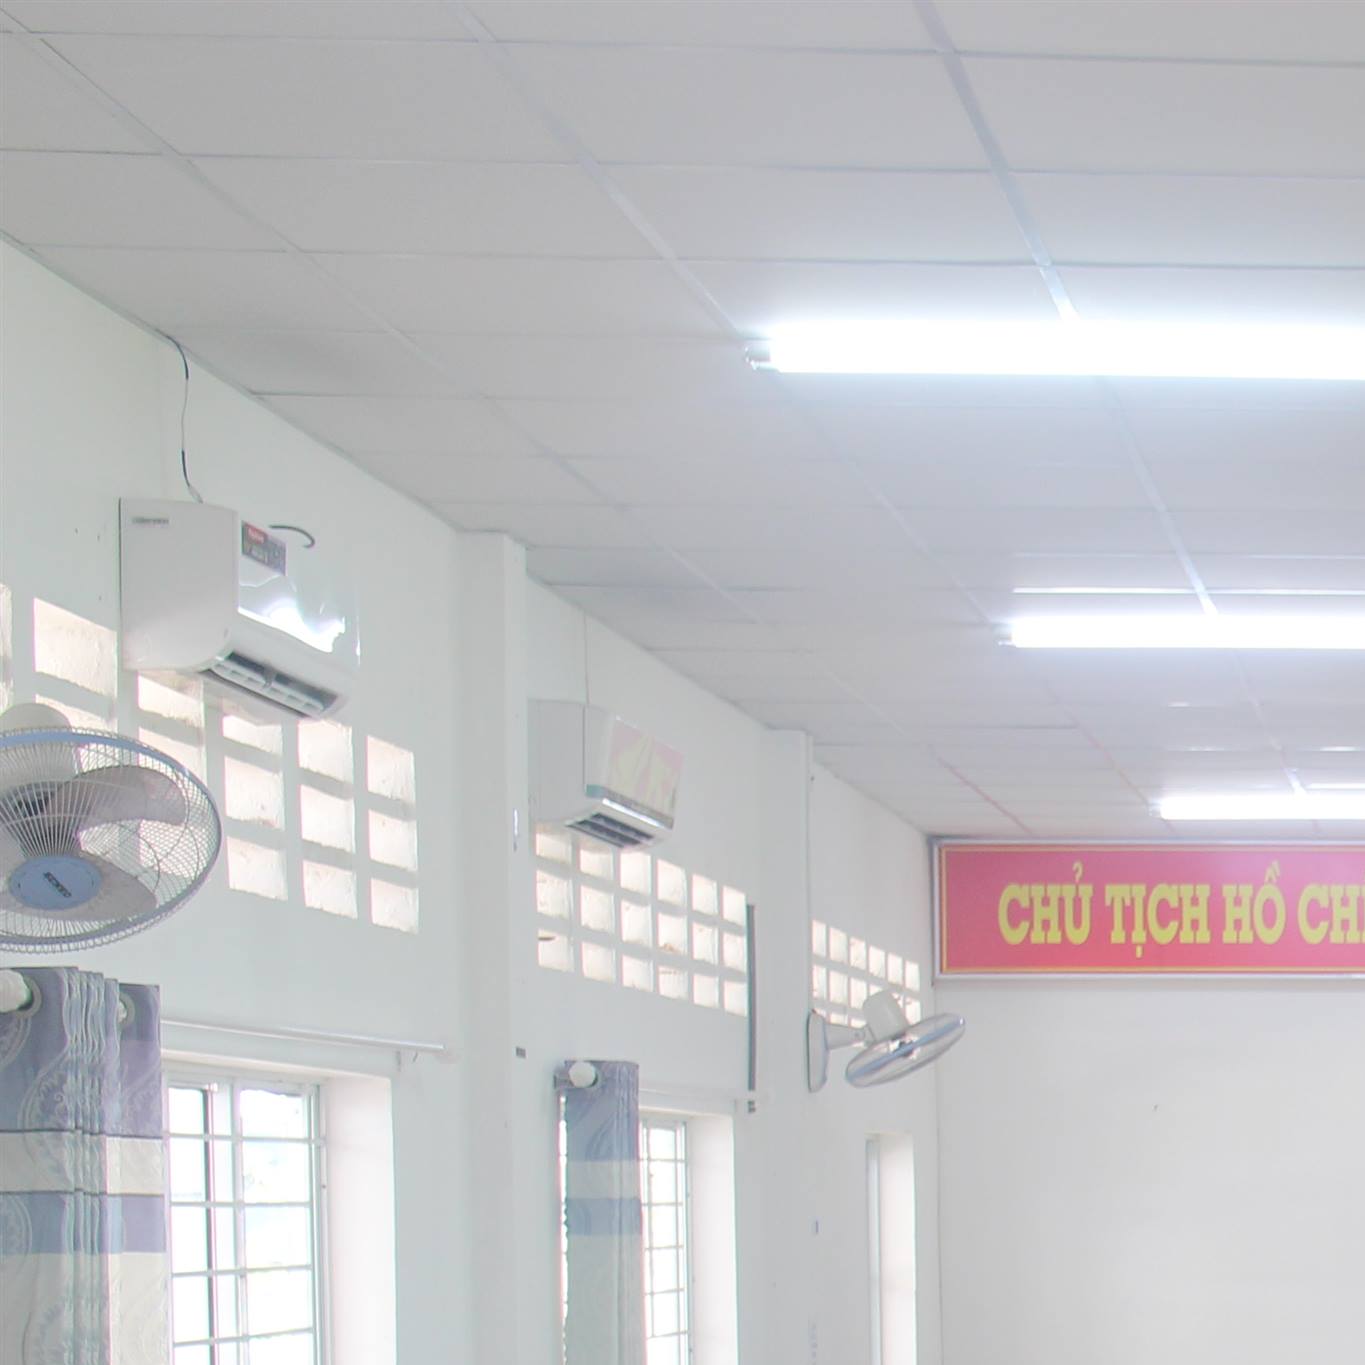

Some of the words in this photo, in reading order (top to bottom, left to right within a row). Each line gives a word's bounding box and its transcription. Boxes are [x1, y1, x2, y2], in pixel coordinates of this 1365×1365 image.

[999, 862, 1093, 945] CHỦ
[1105, 882, 1211, 958] TỊCH
[1222, 860, 1286, 945] HỒ
